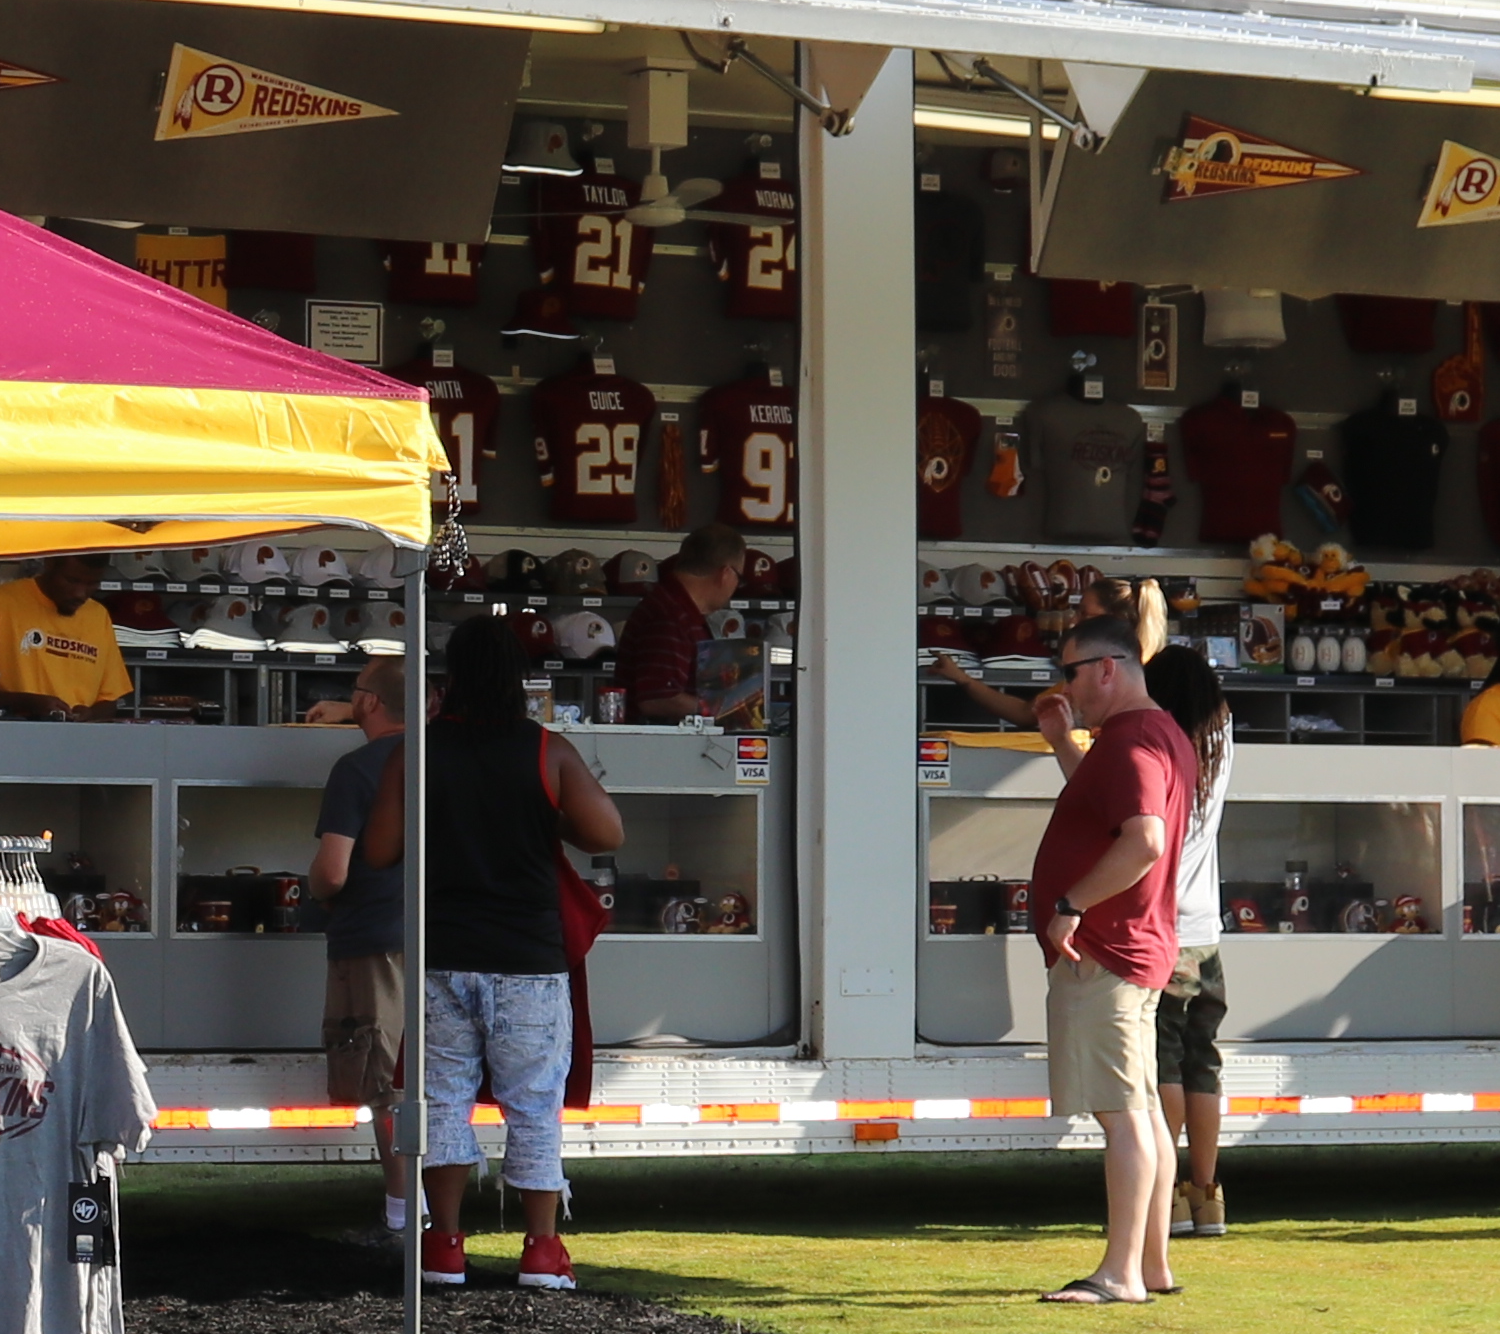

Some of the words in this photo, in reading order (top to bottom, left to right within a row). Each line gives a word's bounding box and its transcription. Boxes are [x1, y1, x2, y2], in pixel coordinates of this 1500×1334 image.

[201, 73, 236, 105] R
[250, 72, 307, 93] WASHINGTON
[250, 83, 362, 117] REDSKINS
[1460, 166, 1489, 194] R
[581, 184, 629, 207] TAYLOR
[574, 214, 634, 290] 21
[425, 380, 464, 400] SMITH
[588, 390, 624, 411] GUICE
[575, 423, 641, 495] 29
[740, 431, 795, 523] 9
[46, 635, 98, 658] REDSKINS
[741, 766, 766, 778] VISA
[922, 769, 947, 780] VISA
